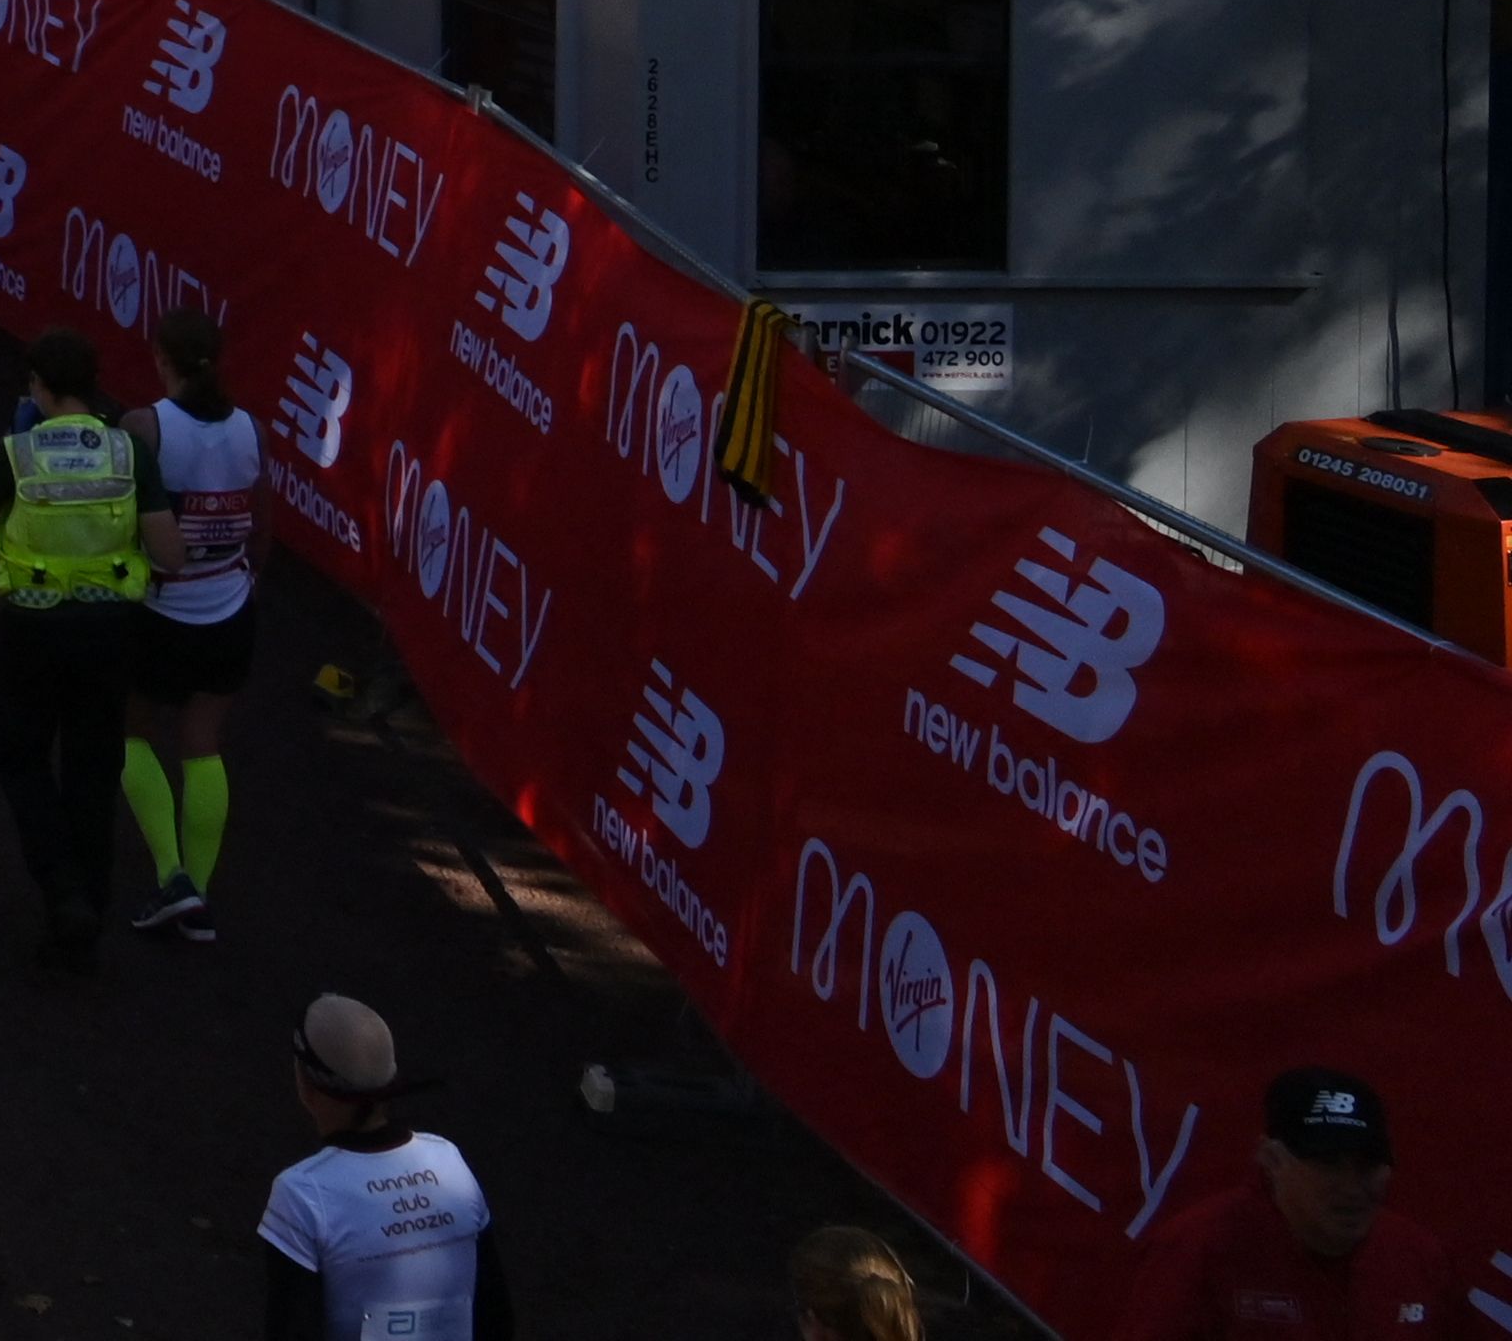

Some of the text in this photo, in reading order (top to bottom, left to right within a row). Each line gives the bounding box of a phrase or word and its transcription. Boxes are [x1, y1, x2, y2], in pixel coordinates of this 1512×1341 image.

[122, 104, 221, 184] new balance
[270, 84, 444, 268] MONEY
[800, 312, 1007, 346] ernick 01922
[921, 350, 1005, 367] 472 900
[448, 319, 553, 436] new balance
[285, 461, 362, 554] balance
[1298, 447, 1430, 500] 01245 208031
[384, 438, 552, 691] MONEY
[903, 684, 1168, 884] new balance
[592, 791, 729, 970] new balance
[789, 836, 1200, 1242] MONEY
[366, 1169, 440, 1194] running
[380, 1210, 455, 1238] venezia
[392, 1193, 431, 1214] club
